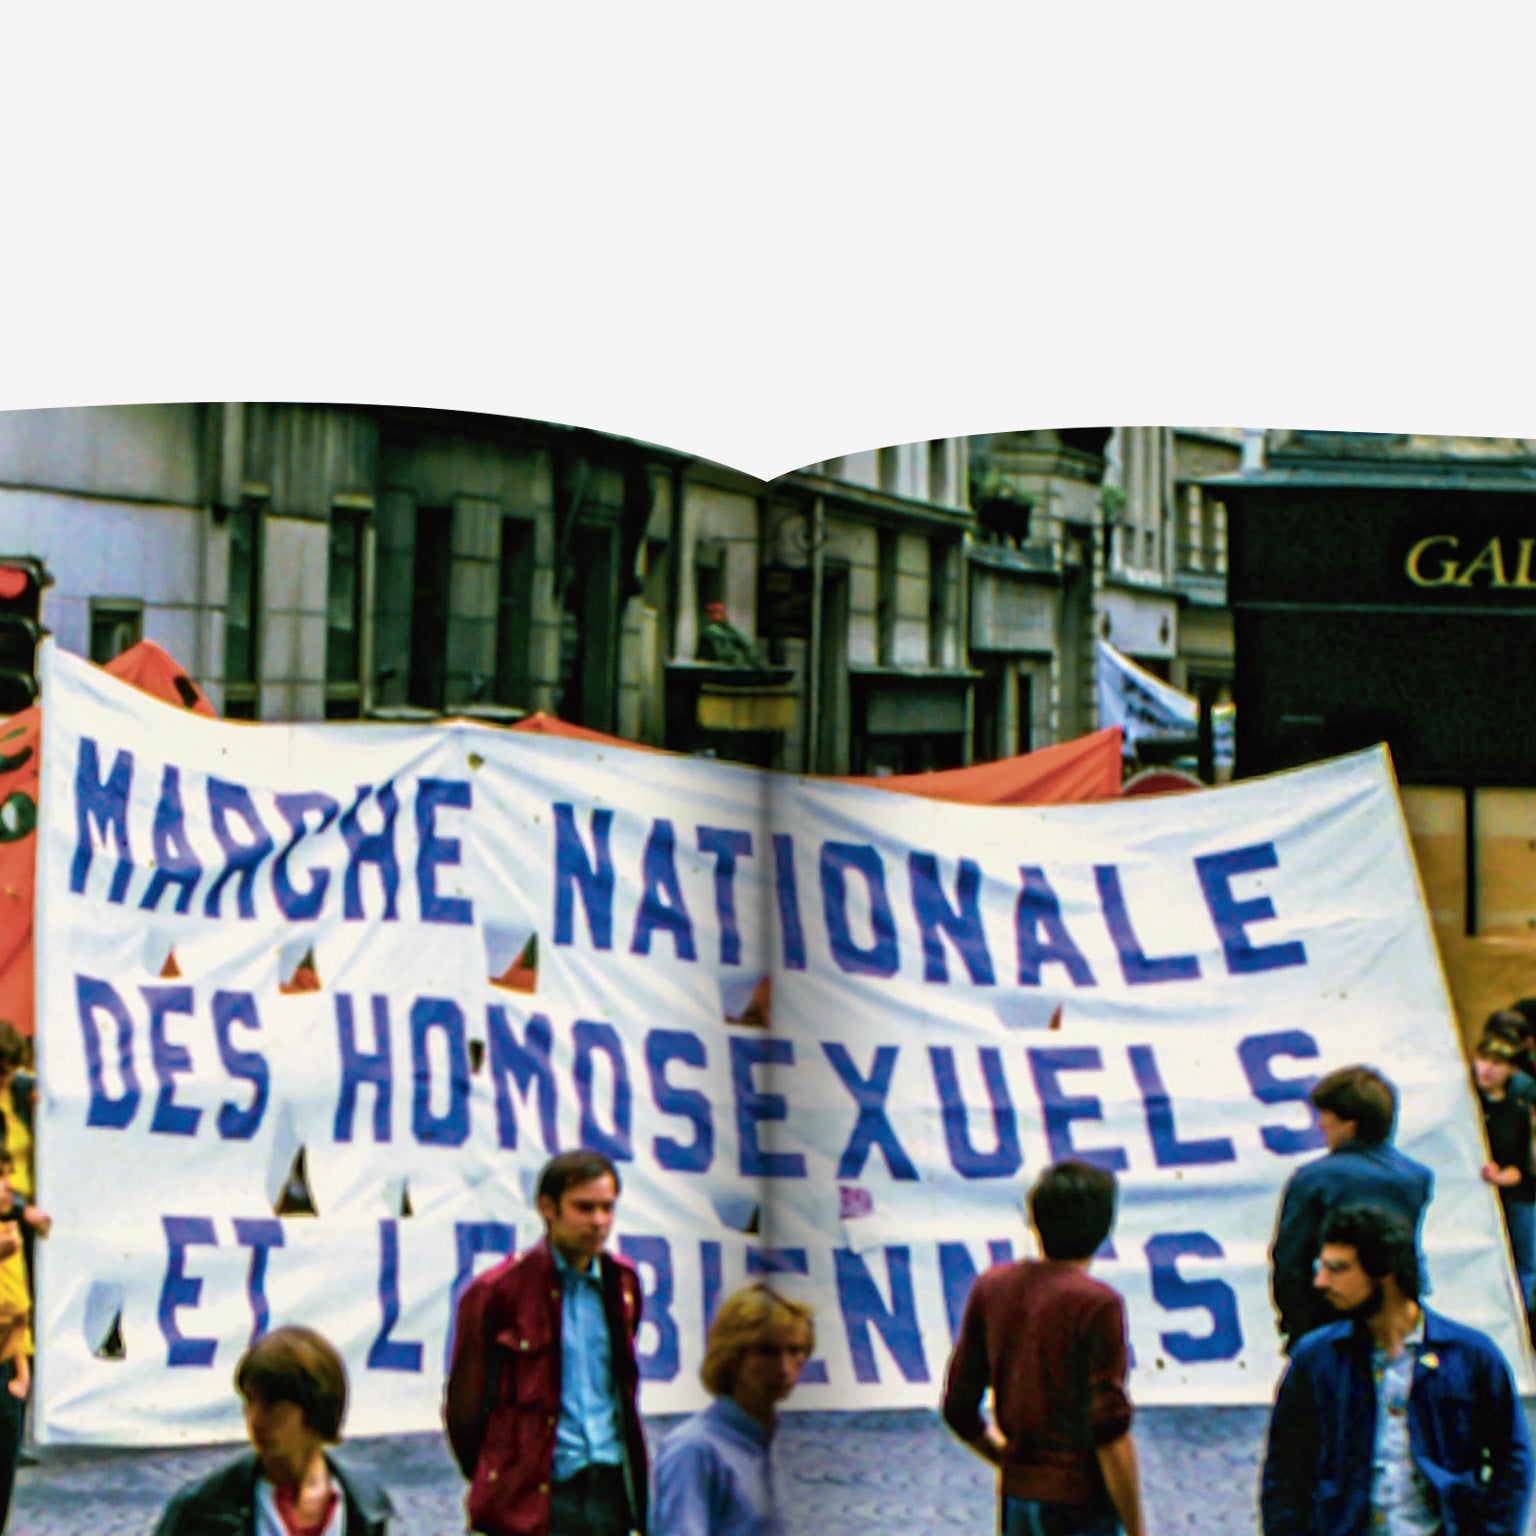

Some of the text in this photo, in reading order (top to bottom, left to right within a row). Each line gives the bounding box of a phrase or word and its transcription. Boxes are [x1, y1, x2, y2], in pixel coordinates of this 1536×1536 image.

[70, 736, 1308, 987] MARCHE NATIONALE
[75, 972, 1330, 1181] DES HOMOSEXUELS
[158, 1215, 285, 1368] ET
